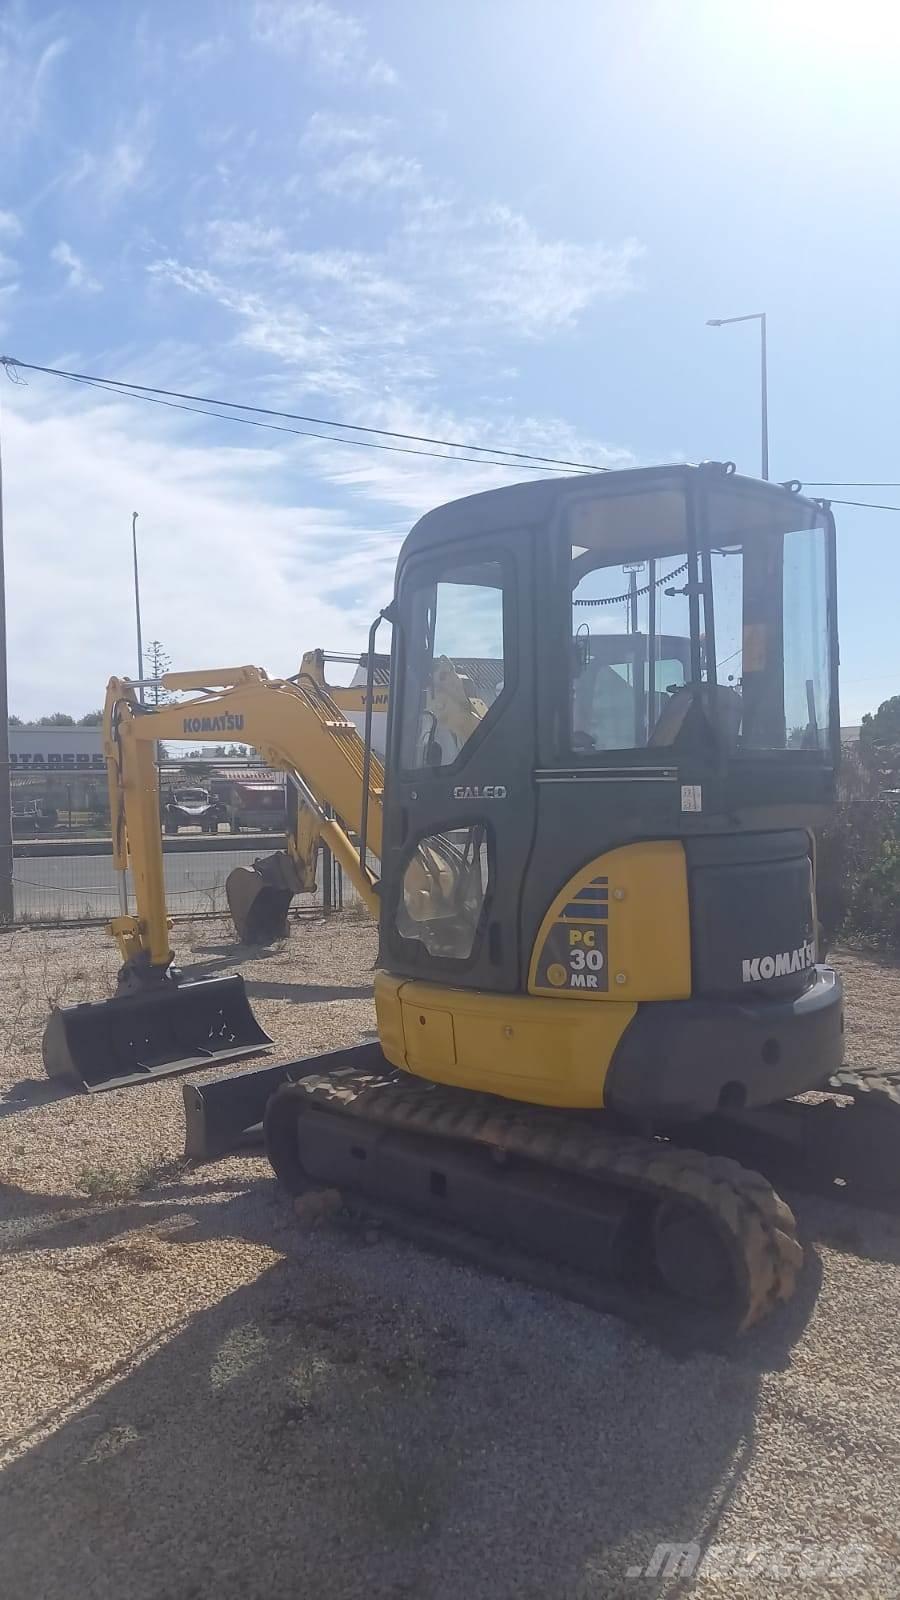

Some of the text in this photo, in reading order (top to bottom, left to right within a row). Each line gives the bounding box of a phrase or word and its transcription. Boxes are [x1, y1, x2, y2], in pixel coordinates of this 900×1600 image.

[183, 710, 244, 734] KOMATSU
[453, 785, 507, 799] GALEO
[569, 929, 595, 946] PC
[569, 949, 604, 970] 30
[570, 974, 598, 988] MR
